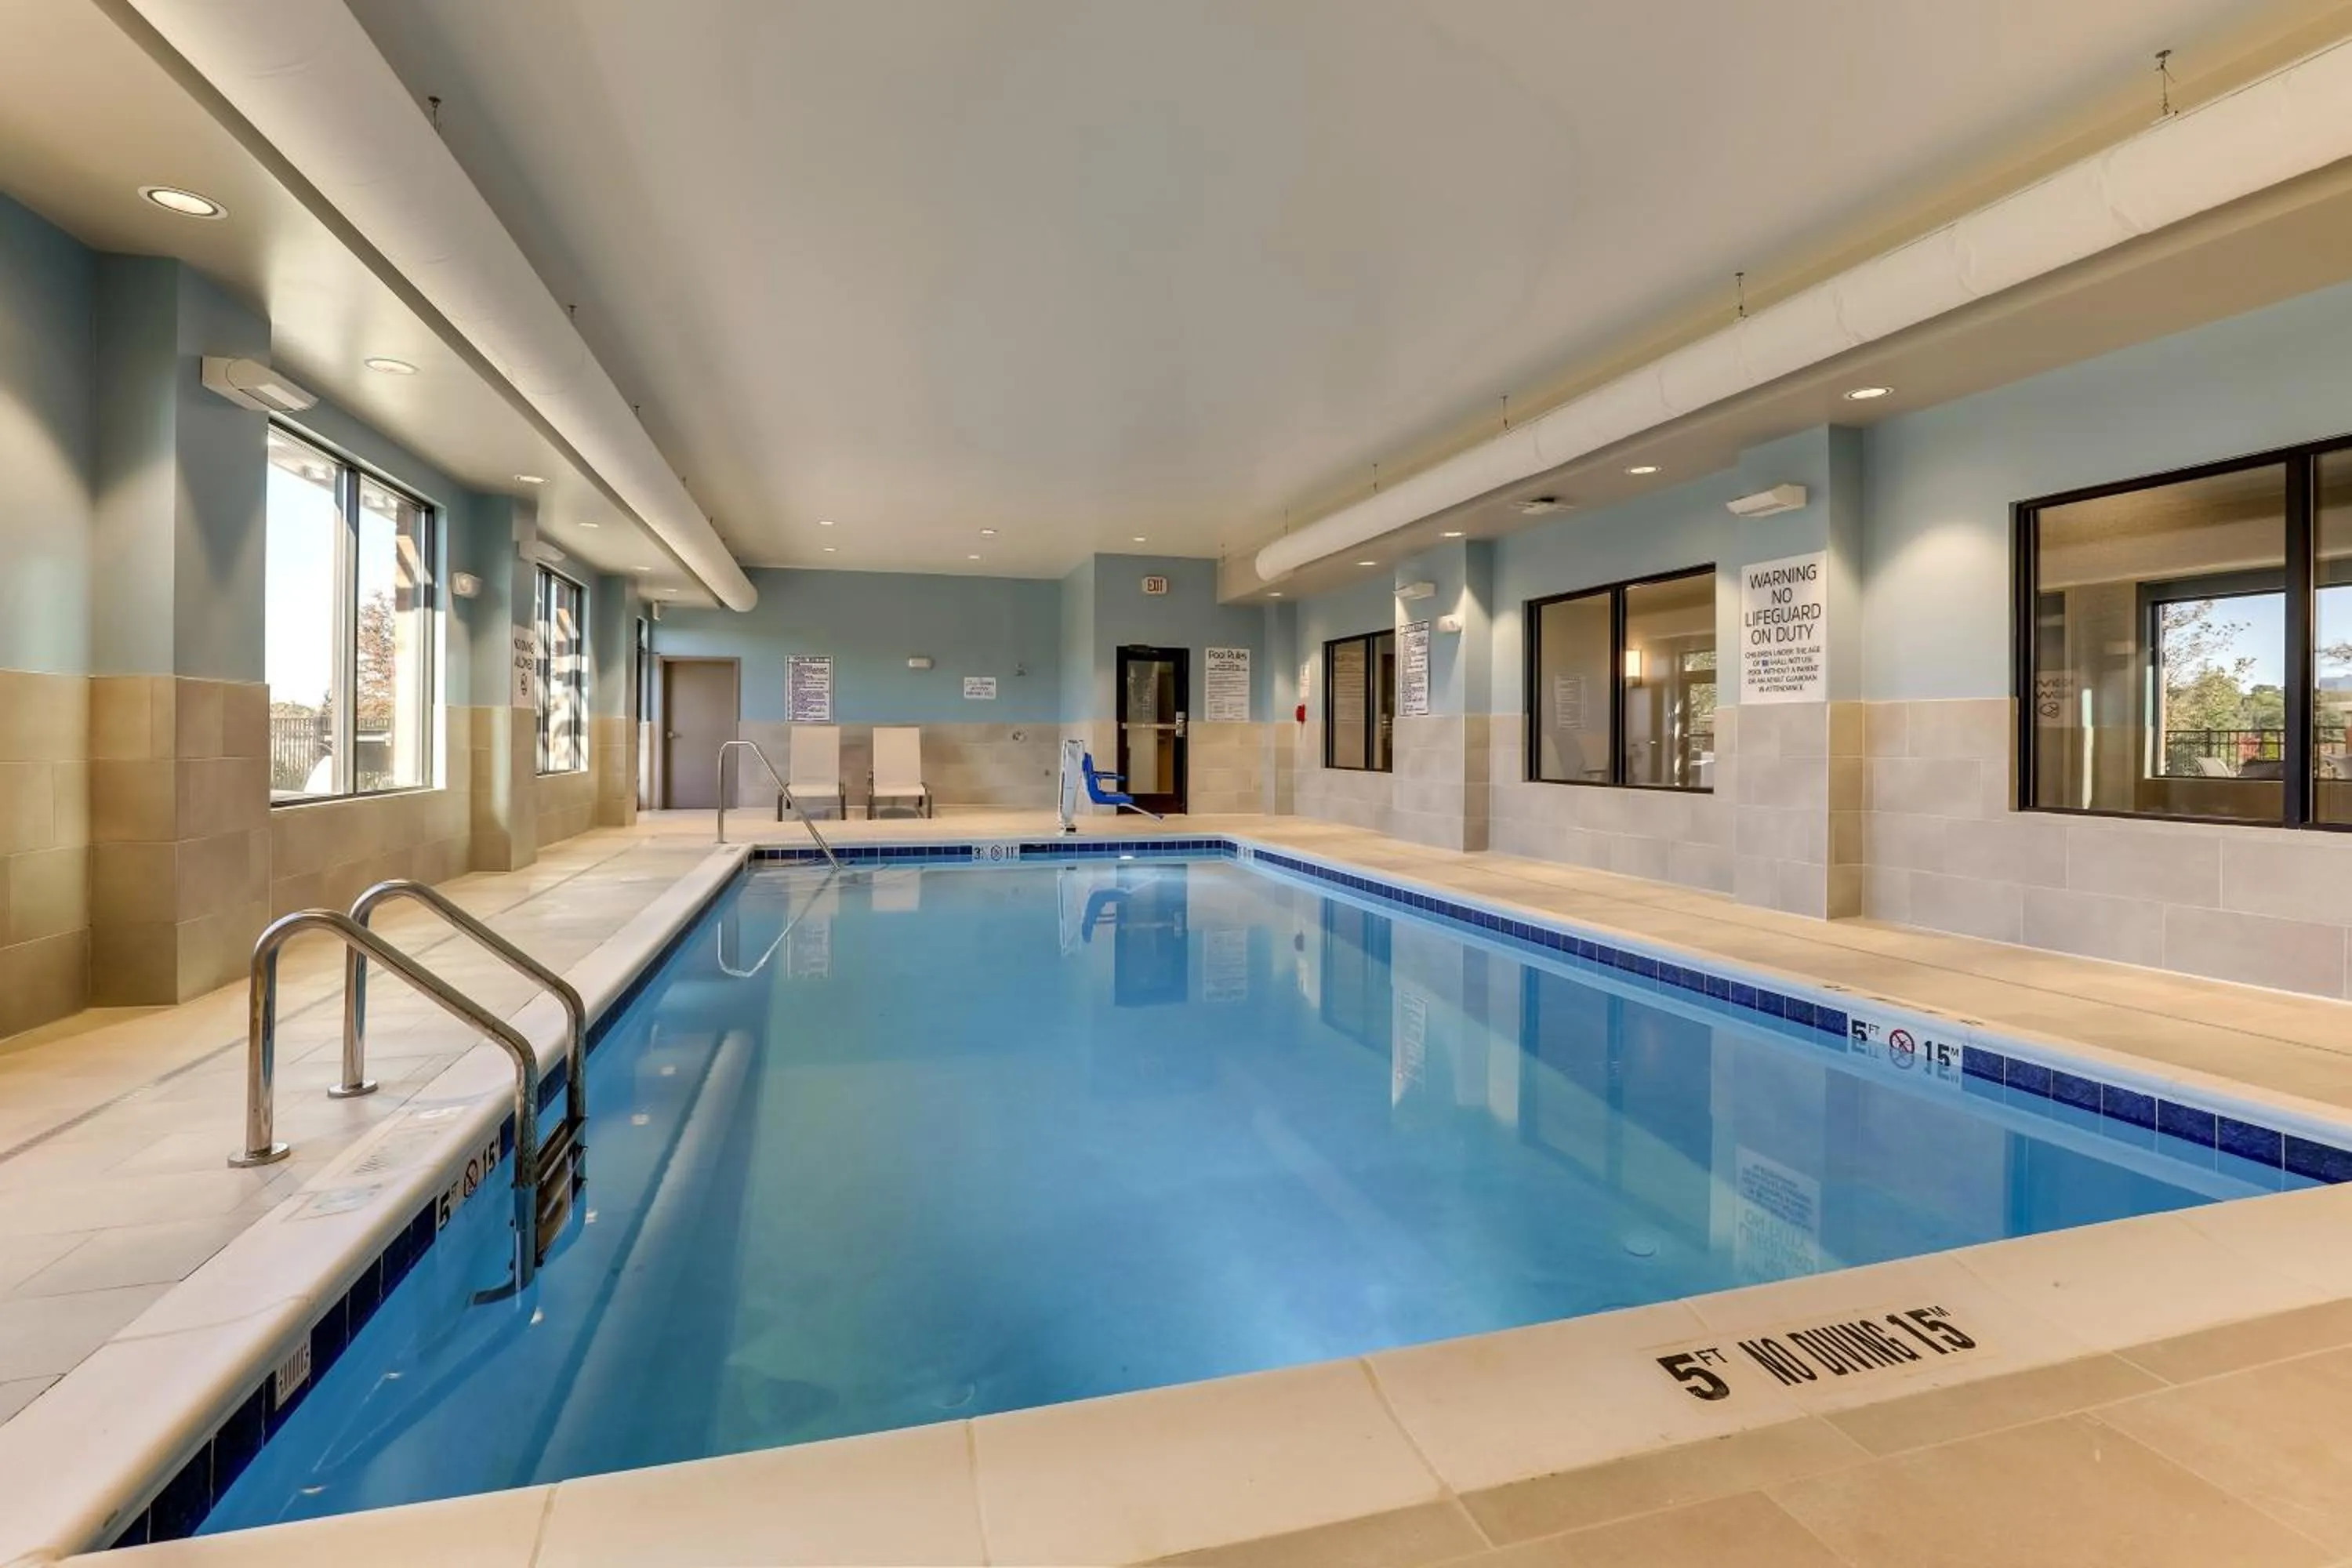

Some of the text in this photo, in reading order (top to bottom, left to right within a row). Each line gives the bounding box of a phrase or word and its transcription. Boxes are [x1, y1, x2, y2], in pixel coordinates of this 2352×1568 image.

[1749, 564, 1817, 590] WARNING
[1771, 588, 1793, 604] NO
[1744, 603, 1821, 627] LIFEGUARD
[1751, 624, 1814, 645] ON DUTY
[1737, 1338, 1818, 1386] NO
[1787, 1319, 1922, 1376] DIVING
